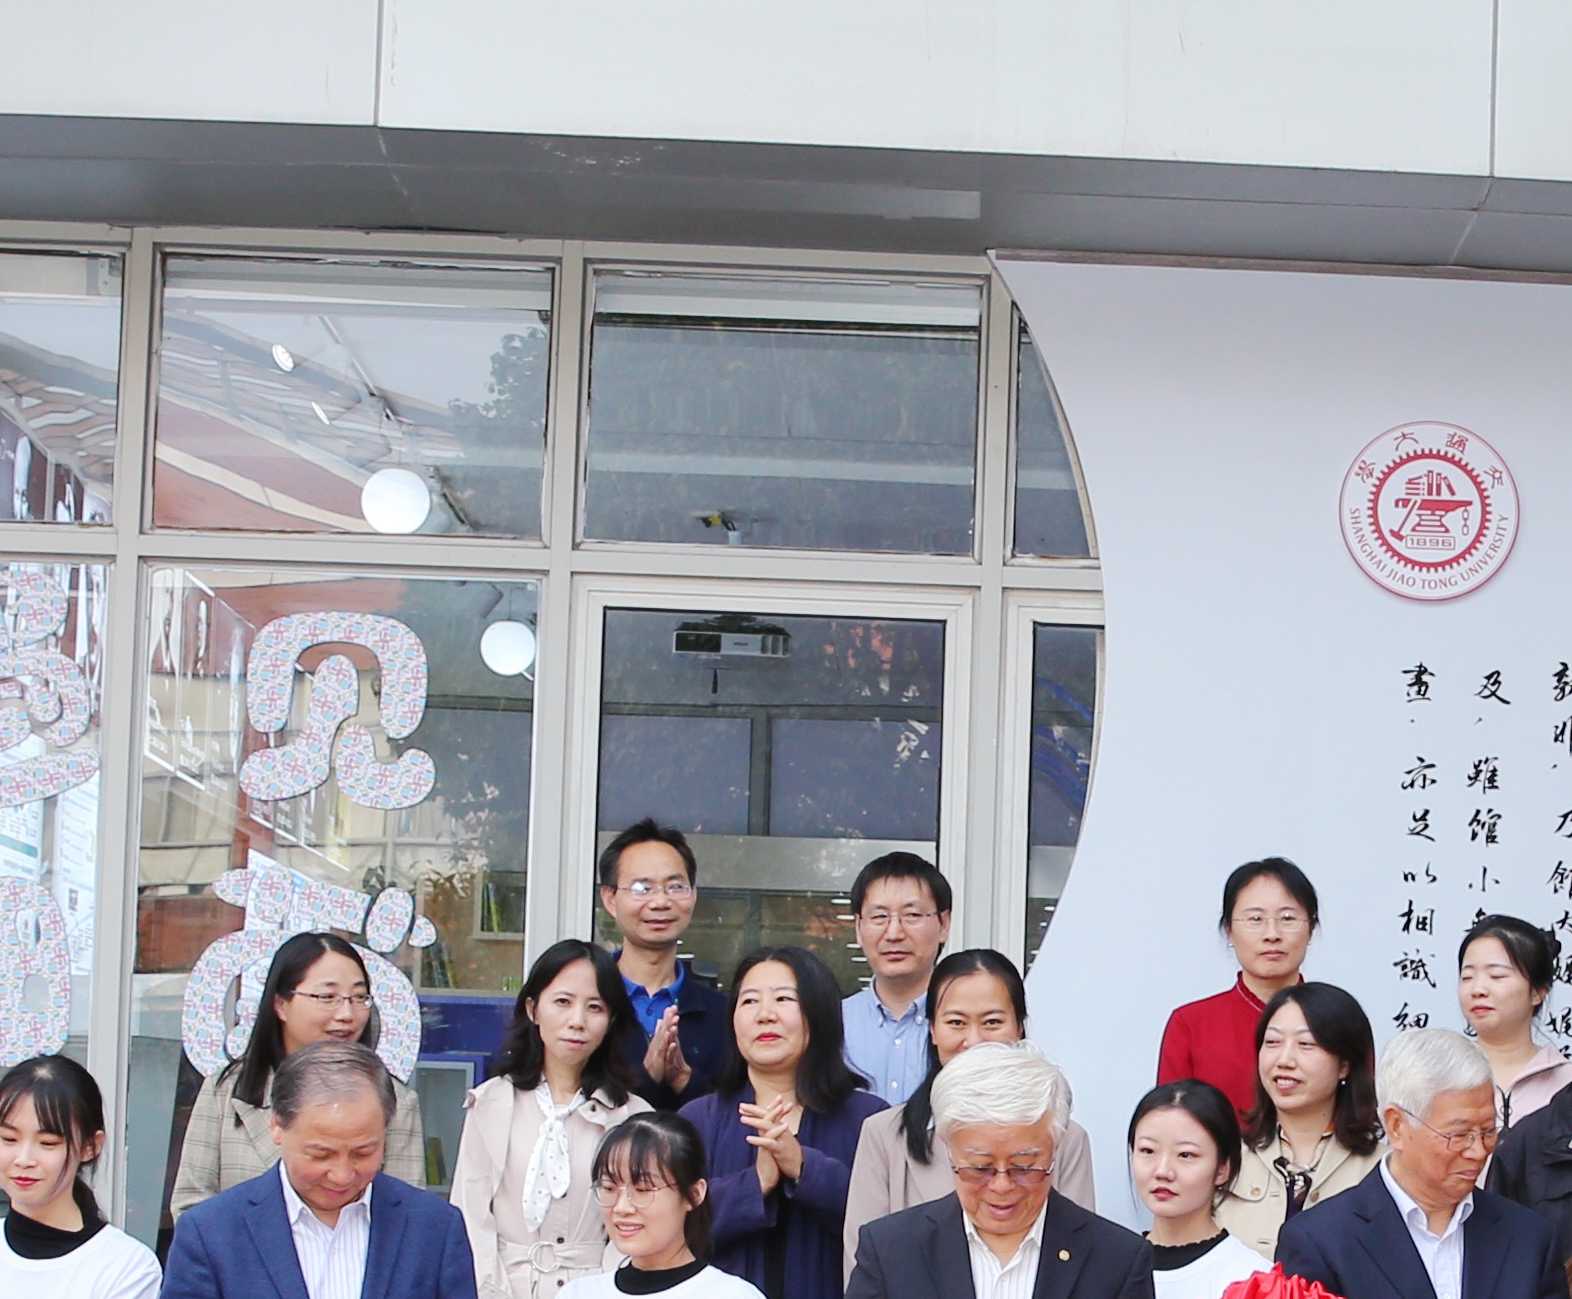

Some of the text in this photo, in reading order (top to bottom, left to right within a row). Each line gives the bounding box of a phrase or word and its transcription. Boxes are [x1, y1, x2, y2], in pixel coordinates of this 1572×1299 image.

[1349, 507, 1509, 590] SHANGHAI JIAO TONG UNIVERSITY
[1408, 537, 1453, 547] 1896
